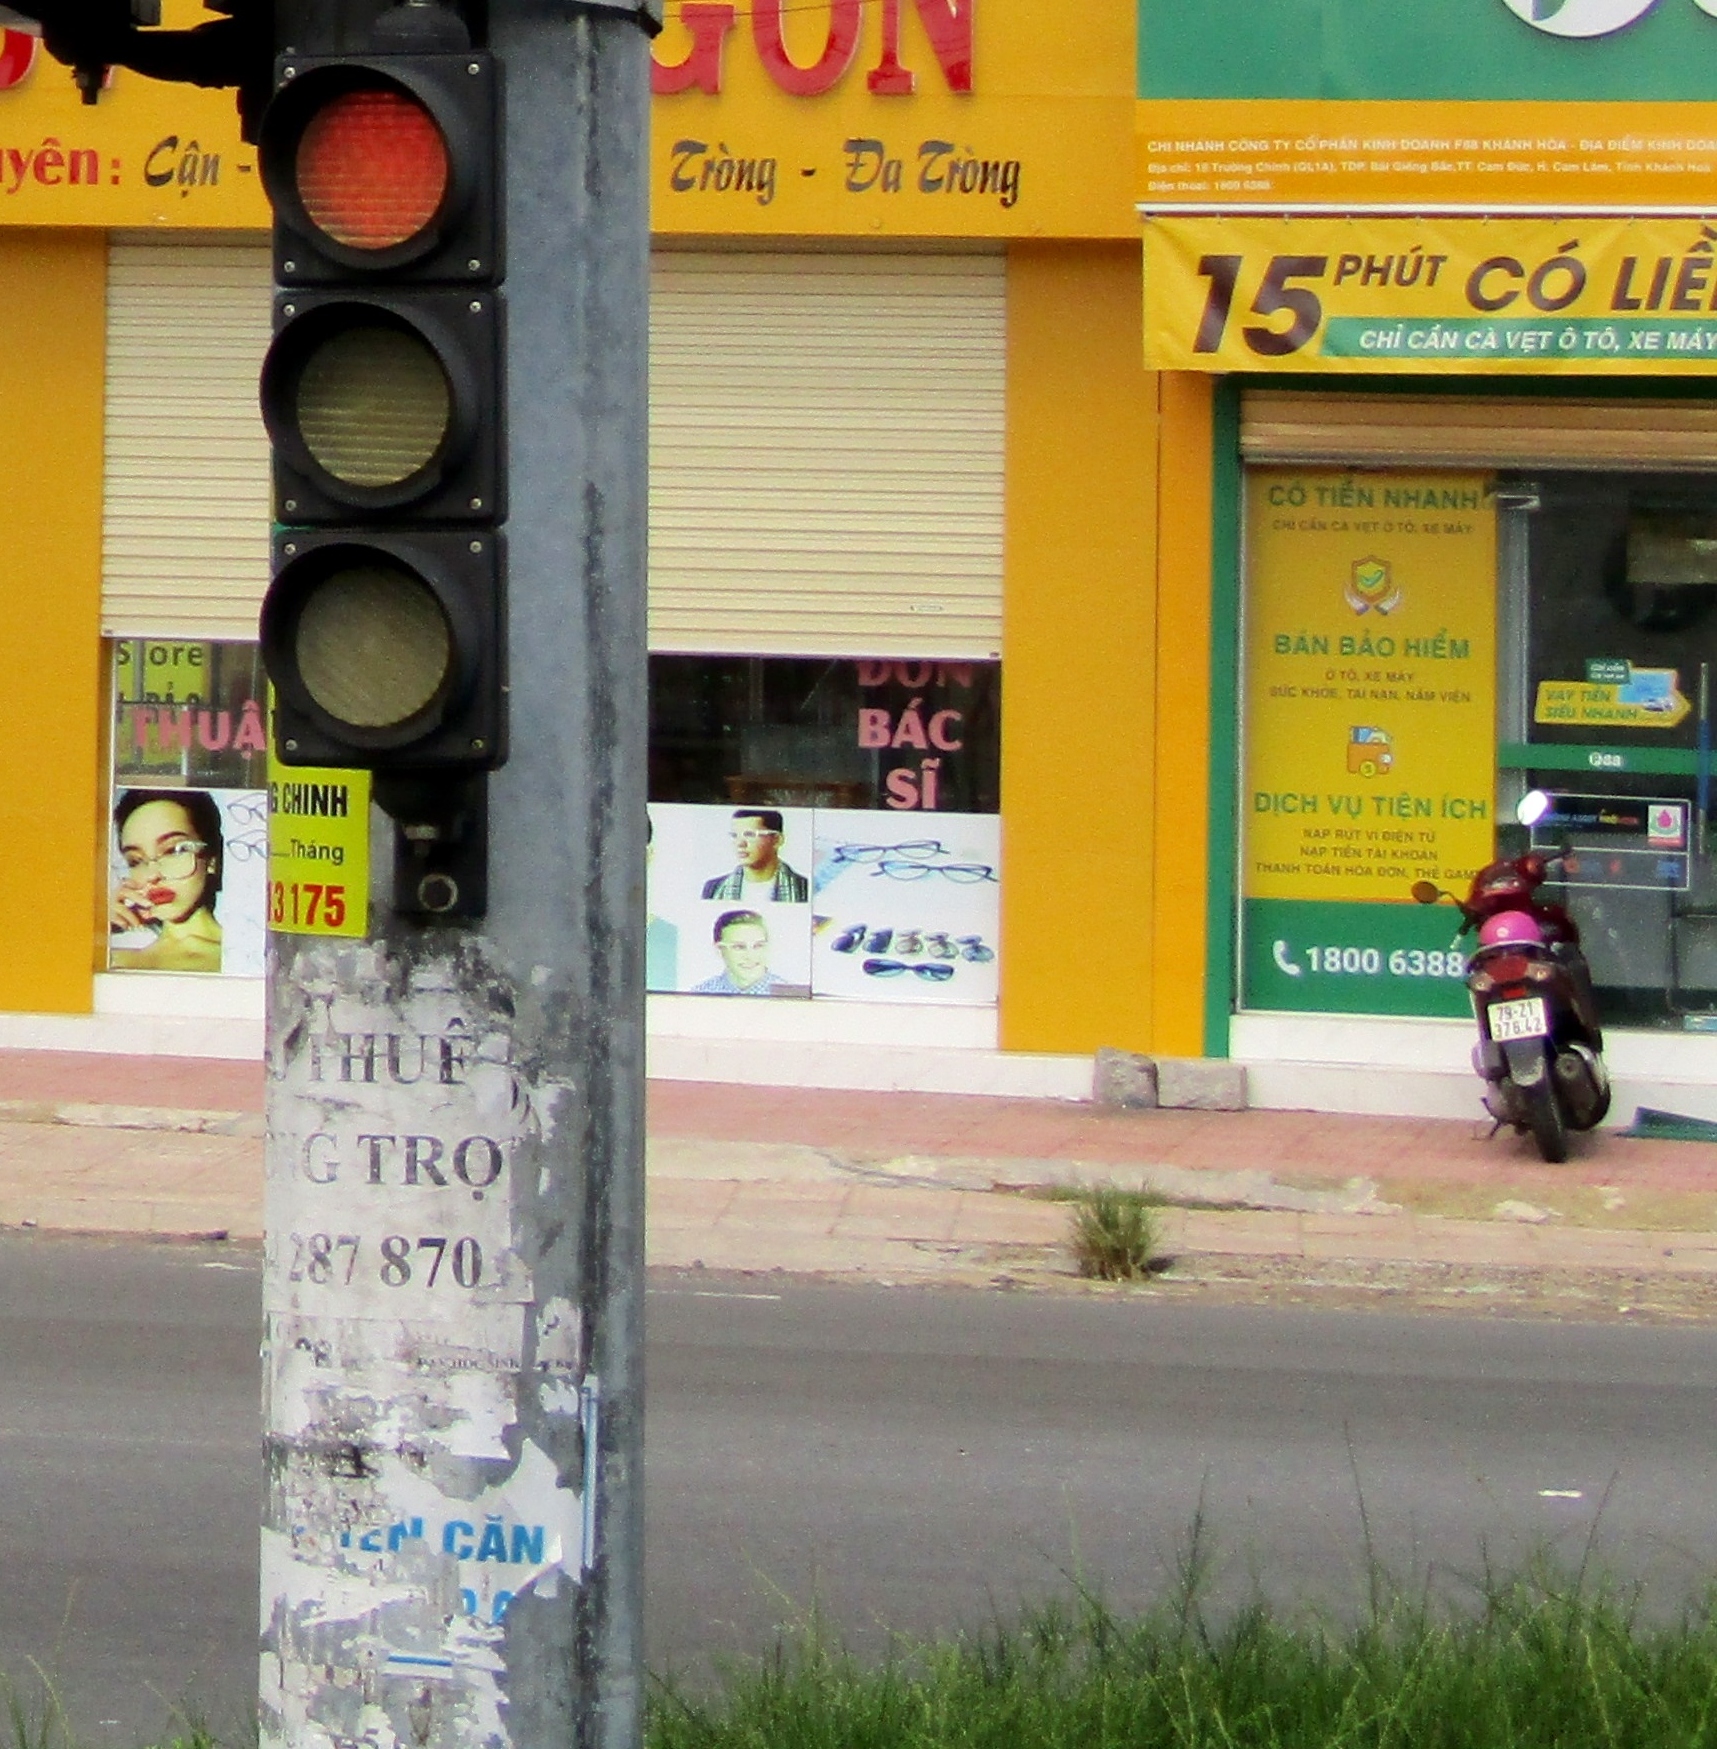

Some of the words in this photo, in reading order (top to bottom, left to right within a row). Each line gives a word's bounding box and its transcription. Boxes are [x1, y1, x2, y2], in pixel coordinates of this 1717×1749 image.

[1147, 141, 1172, 152] CHI
[1274, 140, 1290, 152] TY
[1362, 139, 1396, 151] KINH
[143, 134, 220, 200] Cận
[670, 138, 777, 207] Tròng
[842, 137, 901, 193] Đa
[917, 137, 1022, 208] Tròng
[1193, 254, 1328, 357] 15
[1333, 246, 1449, 288] PHÚT
[1465, 240, 1587, 312] CÓ
[1359, 326, 1403, 350] CHỈ
[1408, 323, 1461, 351] CẦN
[1464, 325, 1499, 352] CÀ
[1504, 328, 1552, 356] VẸT
[1560, 326, 1578, 351] Ô
[1582, 325, 1621, 353] TÔ,
[1627, 329, 1662, 351] XE
[1268, 481, 1306, 507] CÓ
[1316, 478, 1374, 508] TIỀN
[1384, 489, 1478, 509] NHANH
[1275, 630, 1329, 655] BÁN
[1340, 629, 1396, 657] BẢO
[1405, 629, 1470, 659] HIỂM
[858, 696, 963, 751] BÁC
[283, 782, 347, 817] CHINH
[886, 757, 940, 810] SĨ
[1254, 792, 1318, 817] DỊCH
[1328, 796, 1363, 818] VỤ
[1372, 793, 1433, 821] TIỆN
[1442, 793, 1488, 818] ÍCH
[290, 838, 344, 866] Tháng
[1306, 947, 1380, 972] 1800
[1389, 949, 1464, 977] 6388
[357, 1133, 503, 1201] TRỌ
[380, 1234, 483, 1289] 870
